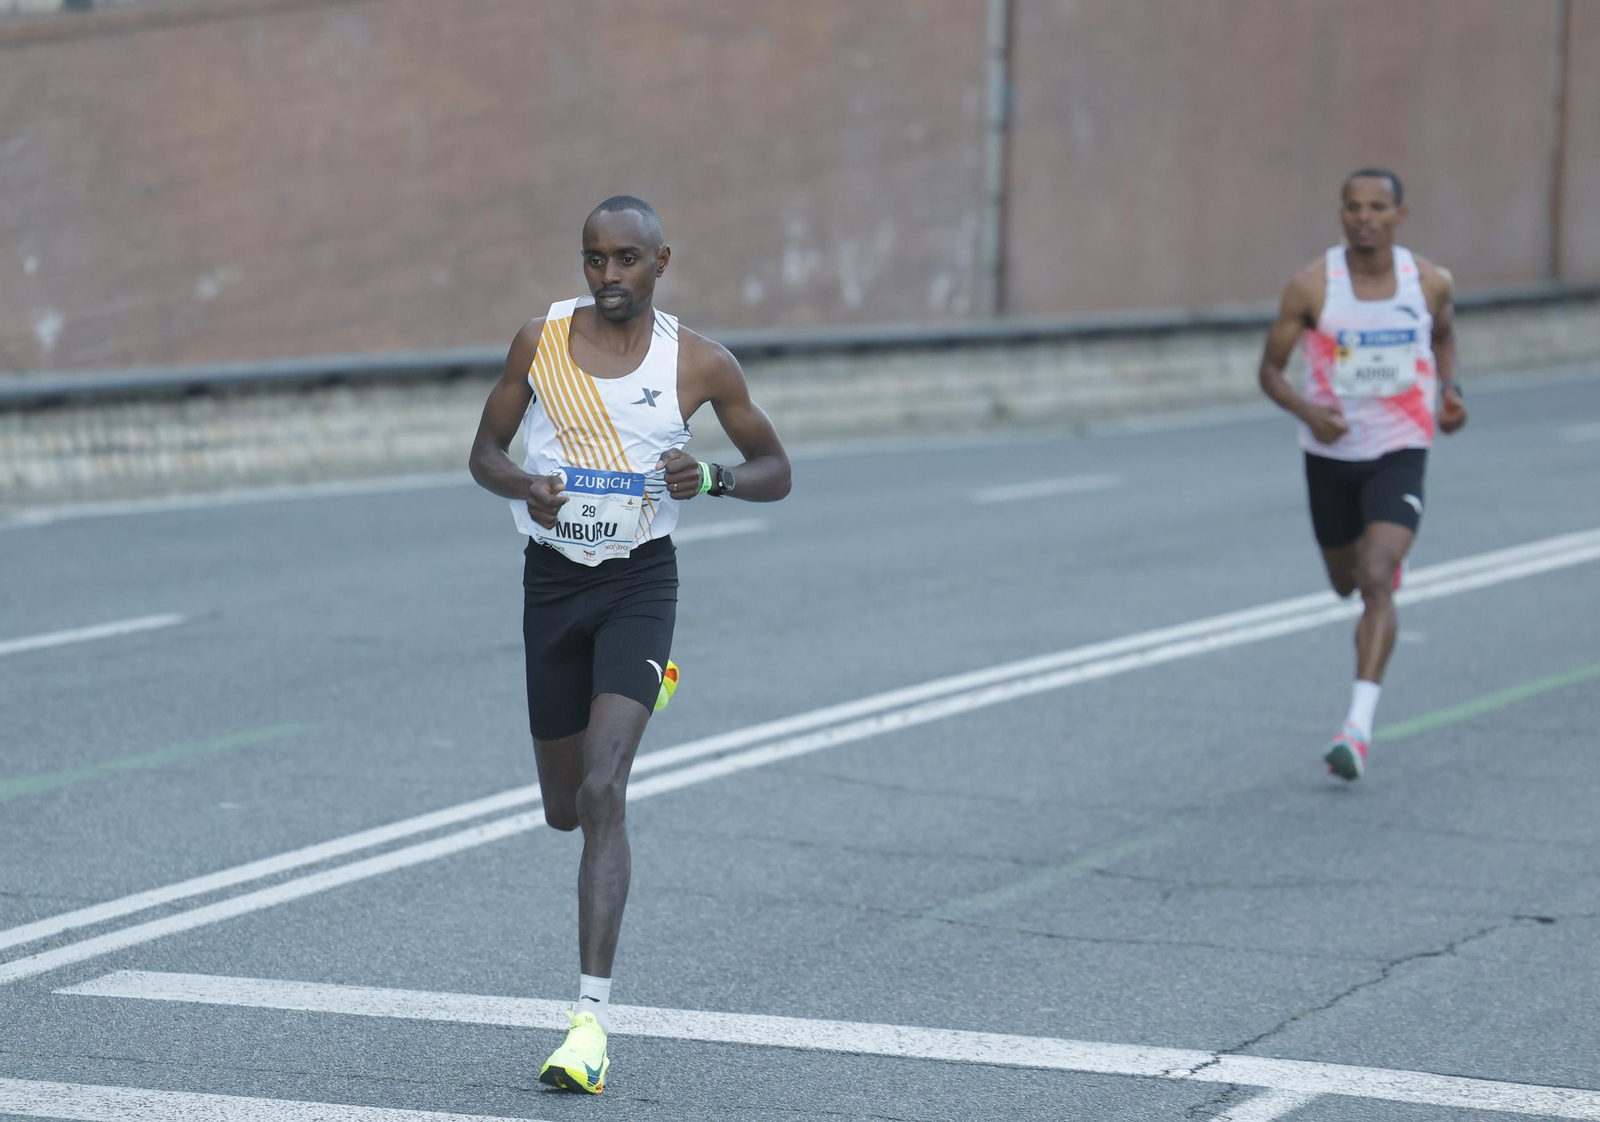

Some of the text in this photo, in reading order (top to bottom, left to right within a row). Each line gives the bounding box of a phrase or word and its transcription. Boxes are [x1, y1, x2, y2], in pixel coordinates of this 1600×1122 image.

[574, 474, 631, 490] ZURICH
[582, 504, 596, 518] 29
[556, 520, 618, 542] MBURU
